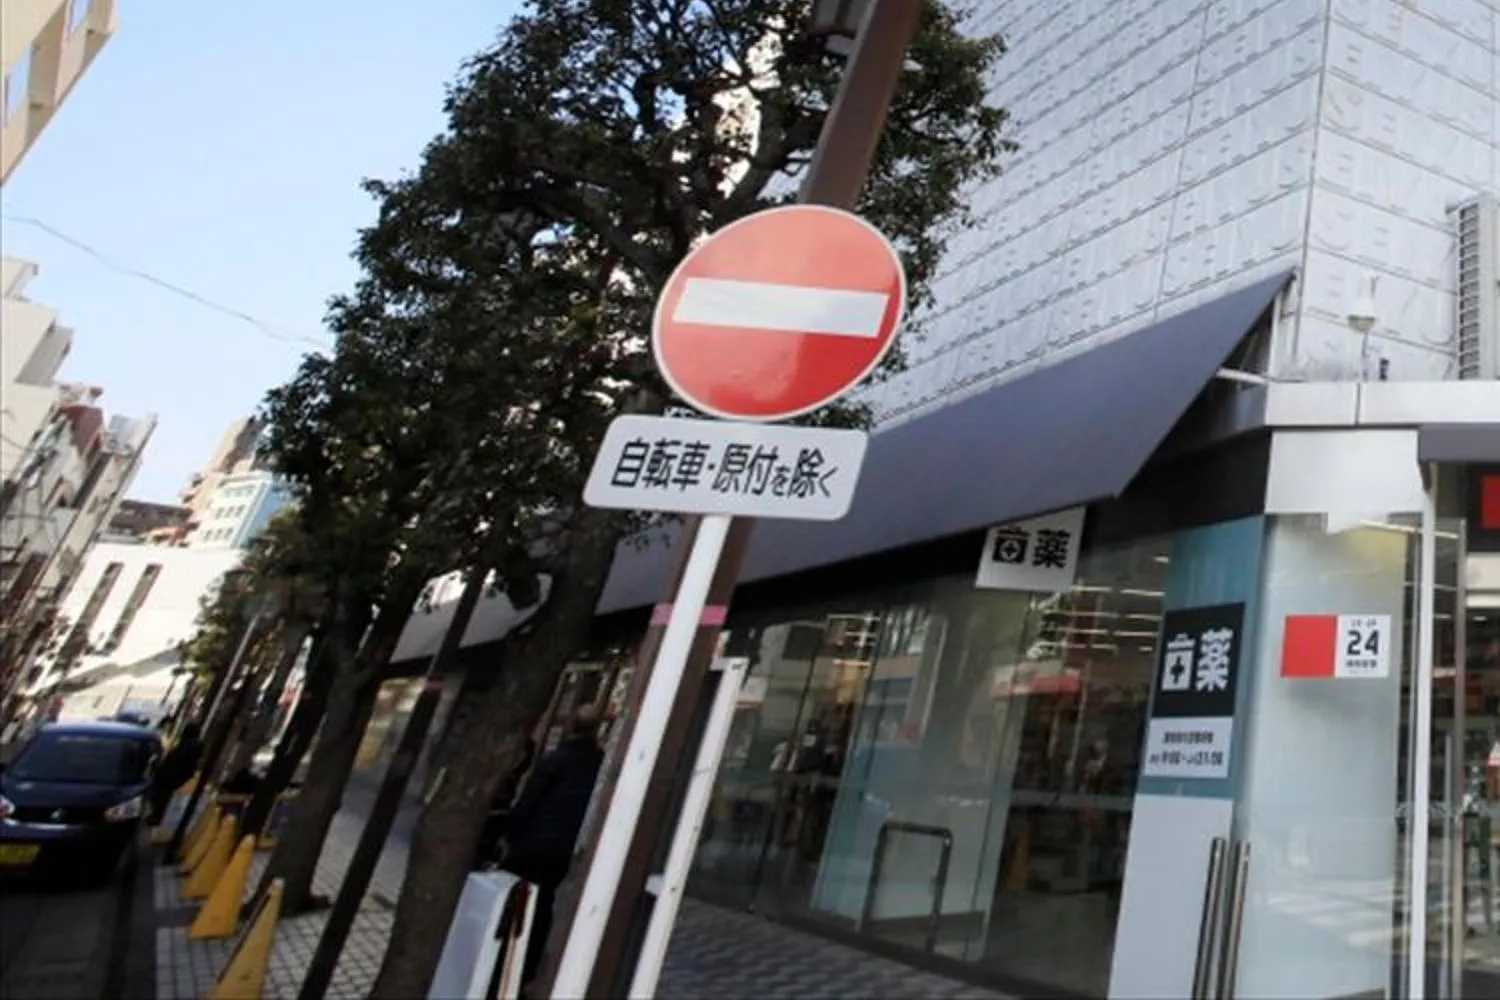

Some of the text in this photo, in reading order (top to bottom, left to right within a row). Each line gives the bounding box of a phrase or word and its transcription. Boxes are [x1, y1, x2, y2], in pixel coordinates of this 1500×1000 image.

[1032, 529, 1071, 569] 薬
[1196, 627, 1234, 692] 薬
[1346, 629, 1379, 655] 24
